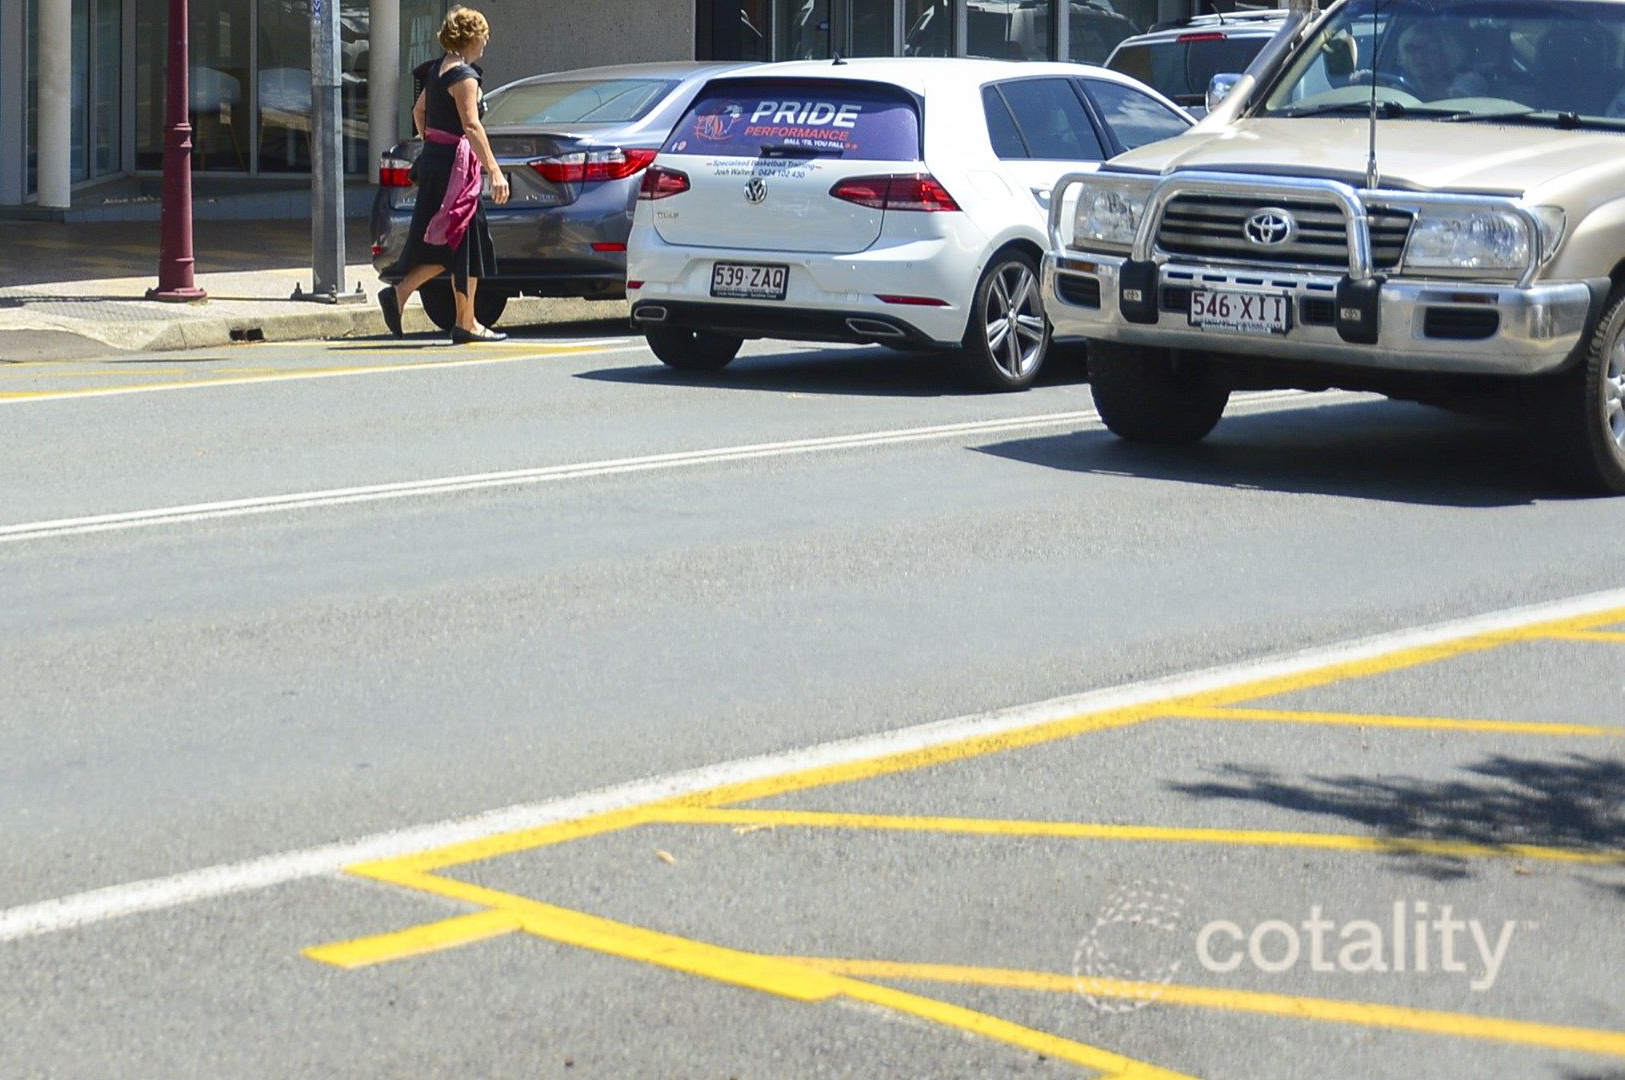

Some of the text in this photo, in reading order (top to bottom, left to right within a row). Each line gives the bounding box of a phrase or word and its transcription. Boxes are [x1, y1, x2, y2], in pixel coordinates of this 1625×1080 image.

[750, 101, 862, 129] PRIDE
[744, 126, 850, 141] PERFORMANCE
[751, 159, 786, 168] Basketball
